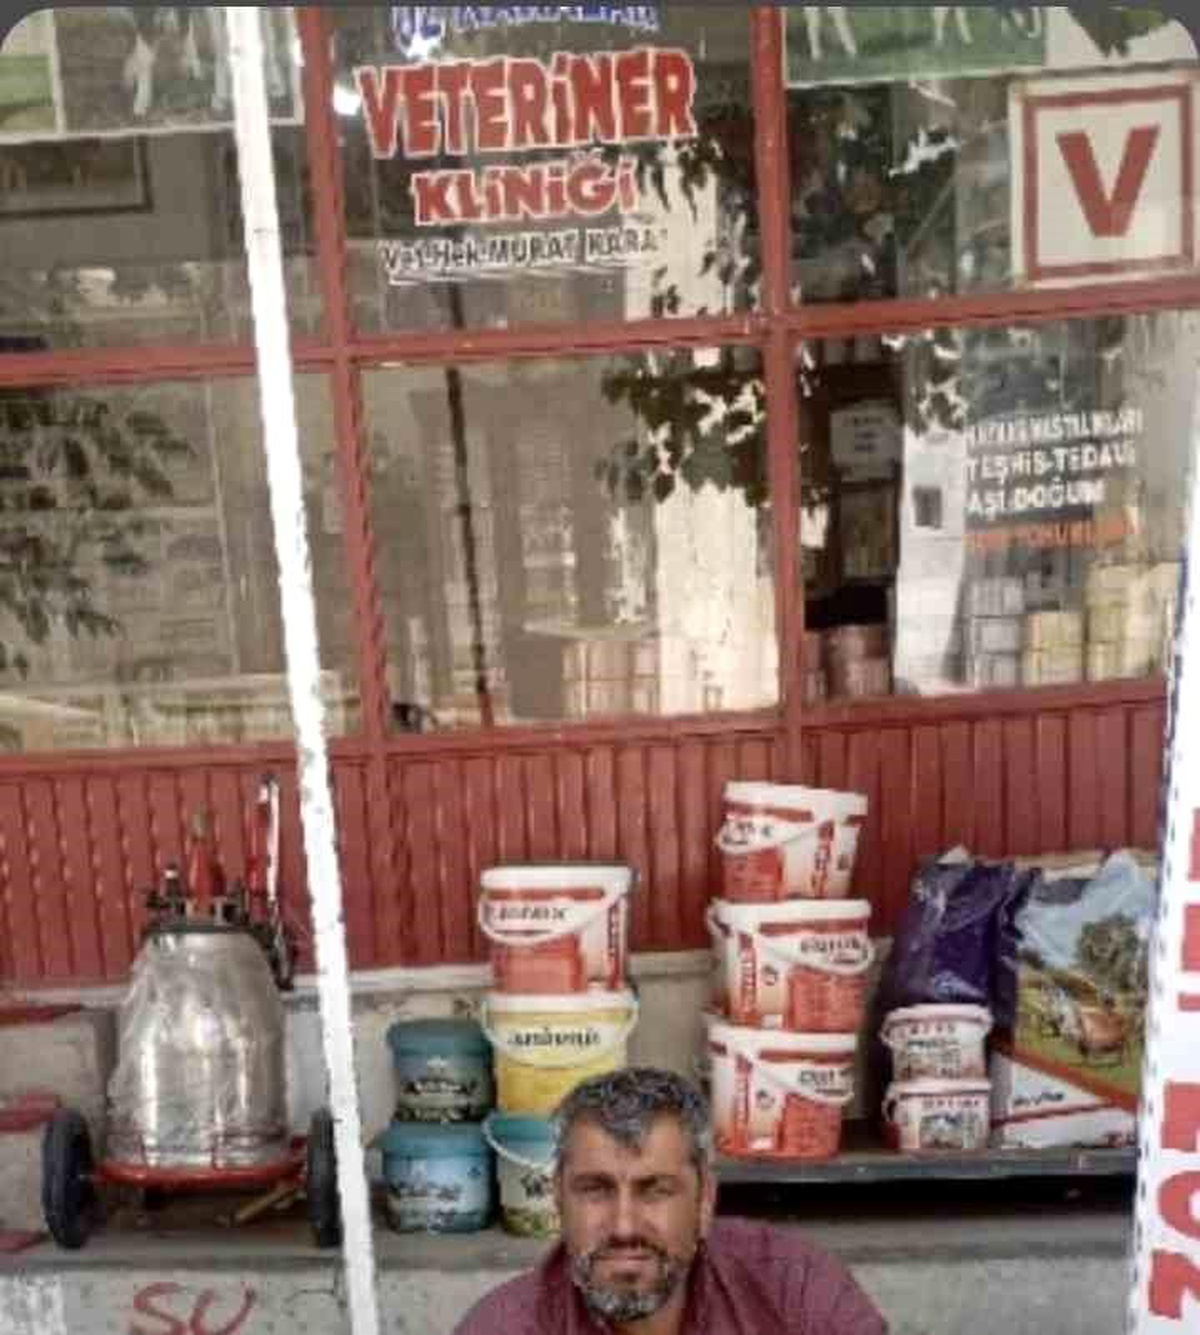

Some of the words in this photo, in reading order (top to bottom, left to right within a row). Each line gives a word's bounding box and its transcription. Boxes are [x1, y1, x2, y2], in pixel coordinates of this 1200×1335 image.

[355, 48, 697, 158] VETERİNER
[412, 150, 638, 226] KLİNİĞİ
[1055, 123, 1160, 238] V
